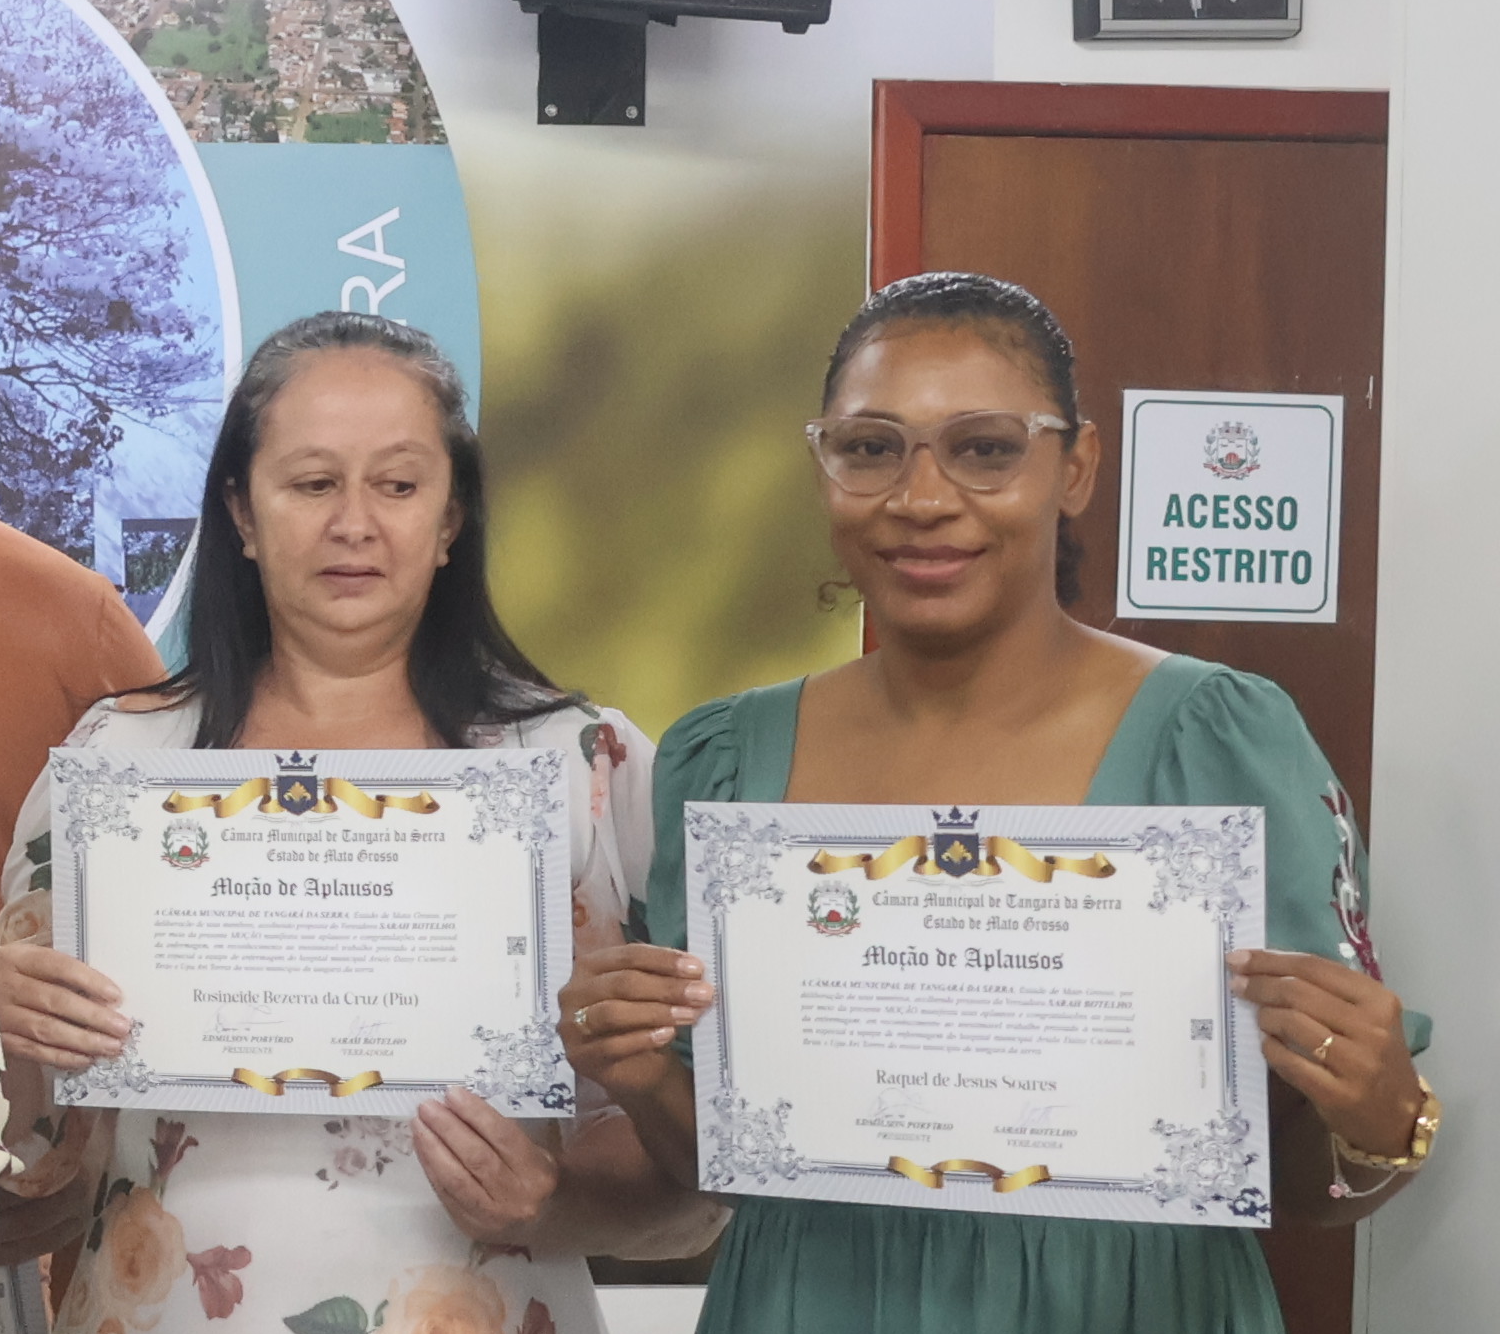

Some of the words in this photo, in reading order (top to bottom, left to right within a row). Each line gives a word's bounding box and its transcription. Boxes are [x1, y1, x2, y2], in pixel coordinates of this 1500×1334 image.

[1163, 493, 1298, 531] ACESSO
[1146, 546, 1312, 585] RESTRITO
[211, 877, 271, 900] Moção
[278, 879, 297, 896] de
[304, 878, 393, 899] Aplausos
[862, 945, 929, 971] Moção
[935, 948, 957, 967] de
[965, 947, 1063, 971] Aplausos
[193, 989, 259, 1003] Rosineide
[263, 991, 318, 1004] Bezerra
[323, 992, 340, 1004] da
[344, 992, 378, 1005] Cruz
[383, 992, 418, 1007] (Piu)
[876, 1069, 928, 1089] Raquel
[932, 1073, 950, 1087] de
[954, 1073, 997, 1088] Jesus
[1002, 1076, 1057, 1091] Soares
